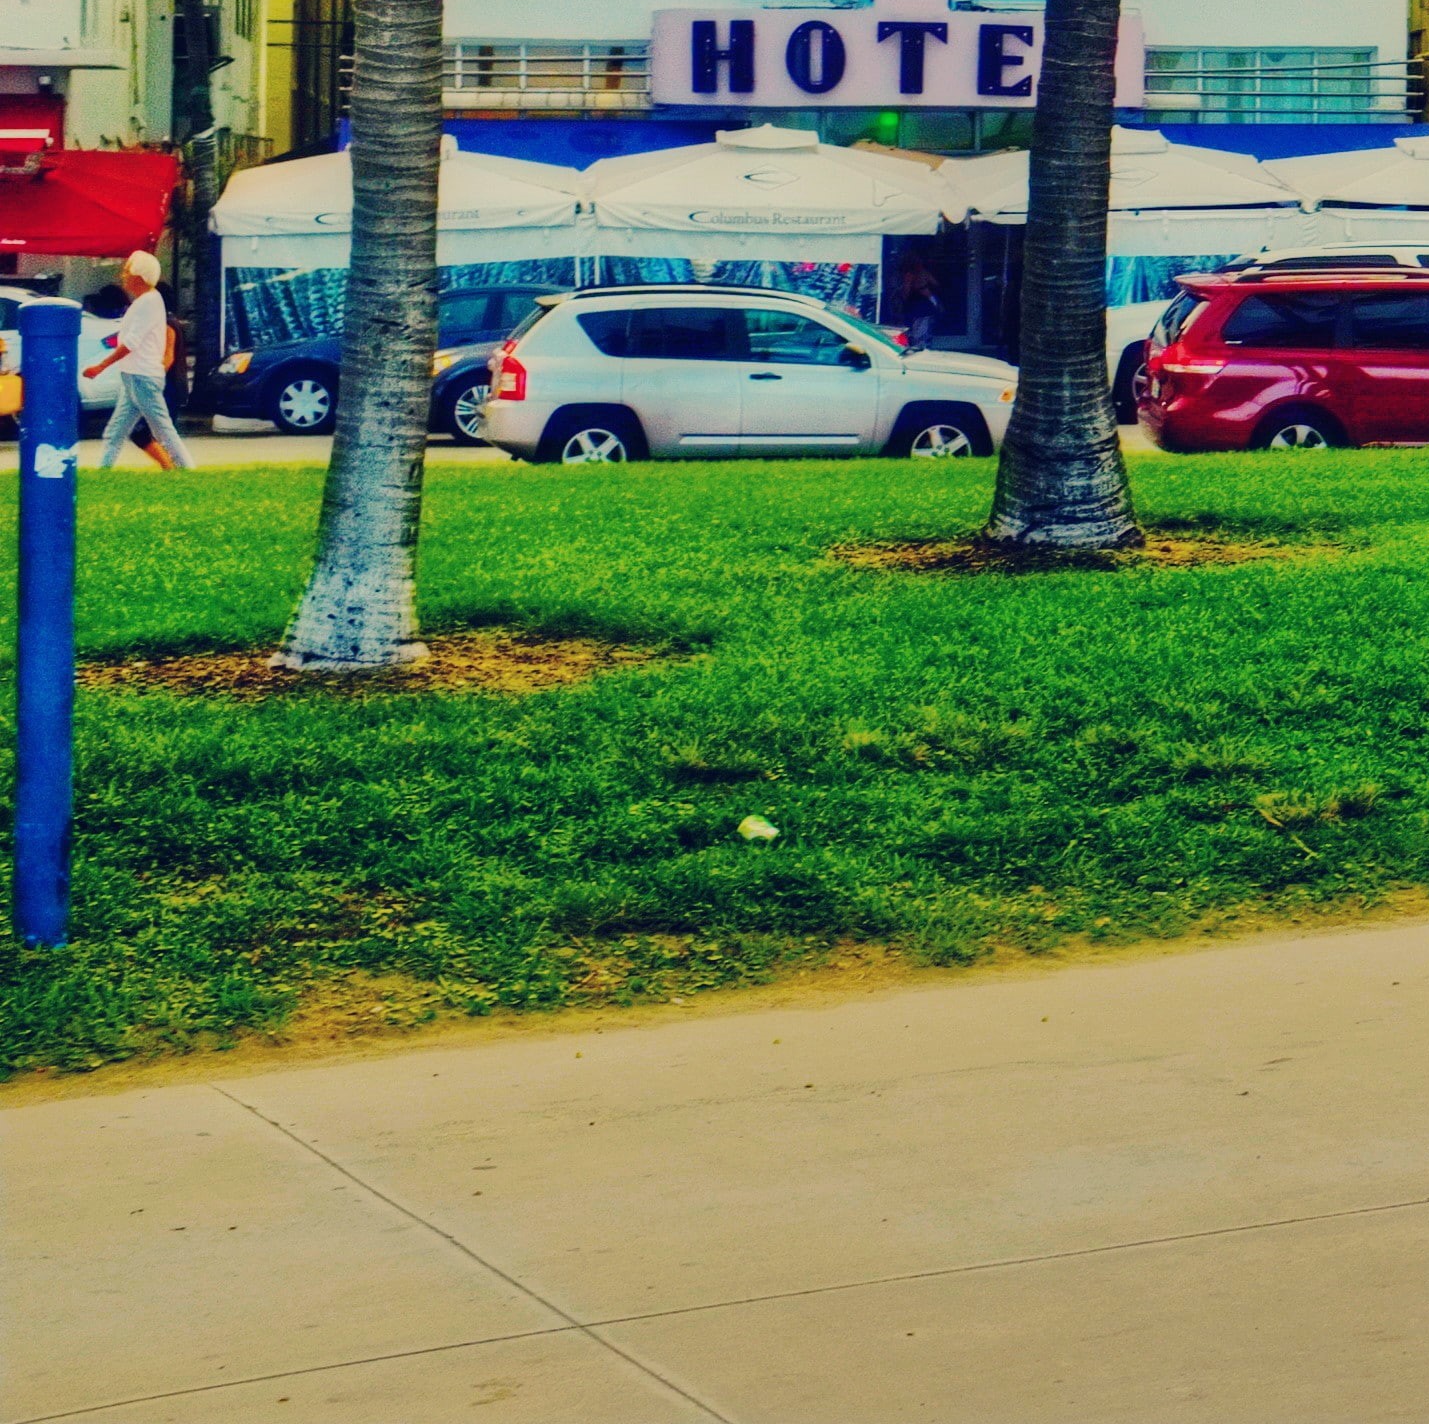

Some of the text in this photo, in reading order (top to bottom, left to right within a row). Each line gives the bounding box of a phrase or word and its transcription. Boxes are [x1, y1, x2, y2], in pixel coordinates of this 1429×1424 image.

[691, 19, 1035, 96] HOTE
[688, 210, 847, 226] Columbus Restaurant
